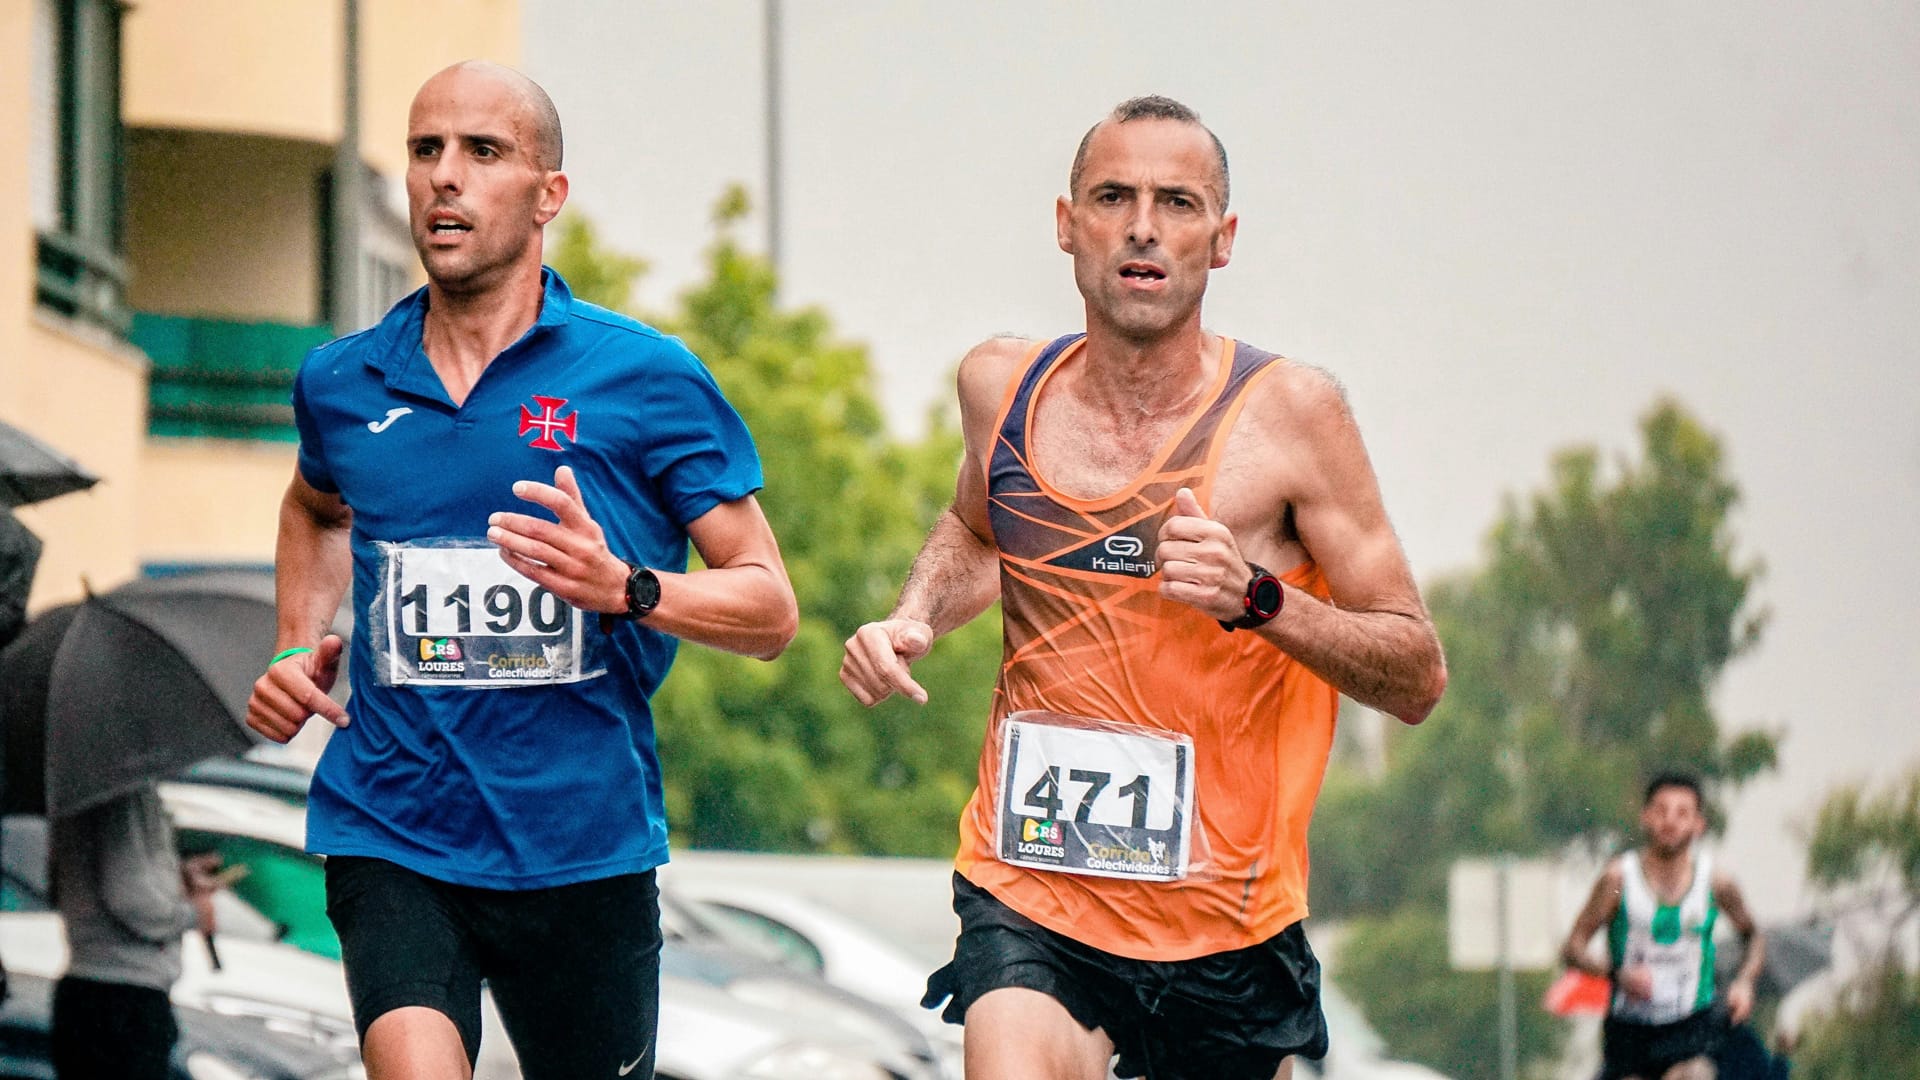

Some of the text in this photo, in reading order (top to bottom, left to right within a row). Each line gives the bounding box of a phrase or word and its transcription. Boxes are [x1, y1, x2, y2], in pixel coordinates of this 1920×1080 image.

[1092, 556, 1156, 577] Kalenji
[401, 584, 567, 633] 1190
[418, 661, 465, 672] LOURES
[1024, 765, 1150, 829] 471
[1017, 842, 1065, 858] LOURES
[1086, 857, 1170, 875] Colectividades
